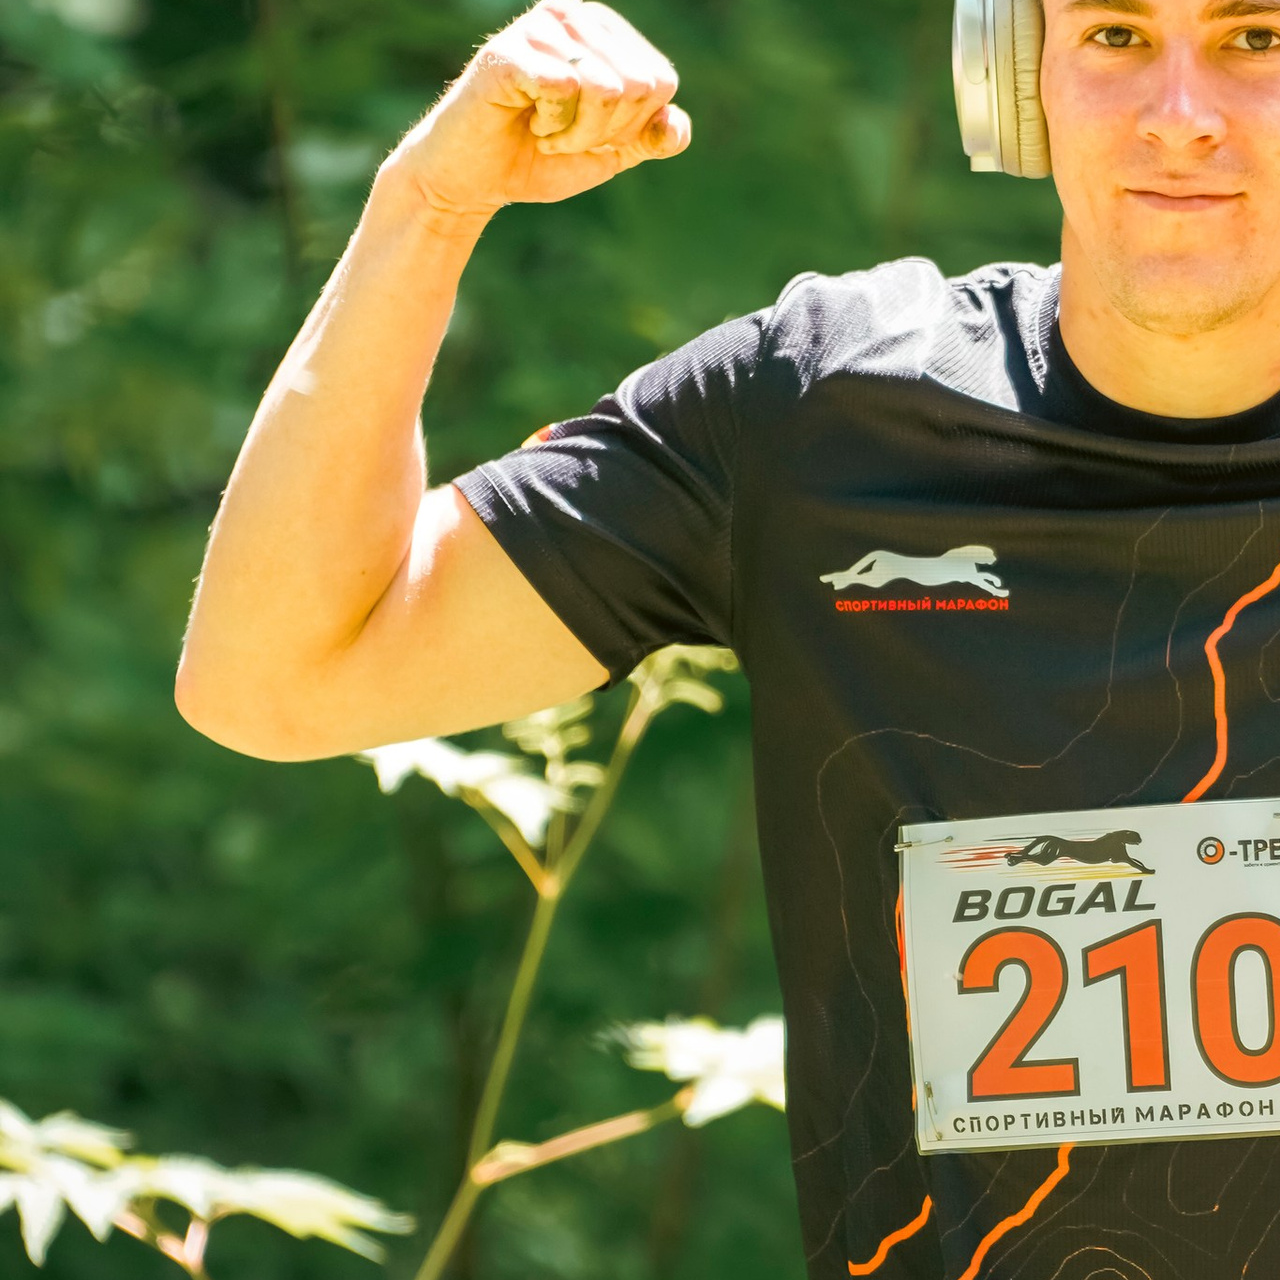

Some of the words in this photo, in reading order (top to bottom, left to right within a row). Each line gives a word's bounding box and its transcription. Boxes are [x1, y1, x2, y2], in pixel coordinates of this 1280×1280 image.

[834, 597, 932, 613] СПОРТИВНЫЙ
[935, 598, 1009, 612] МАРАФОН
[952, 880, 1156, 923] BOGAL
[953, 1107, 1126, 1133] СПОРТИВНЫЙ
[1135, 1099, 1274, 1123] МАРАФОН
